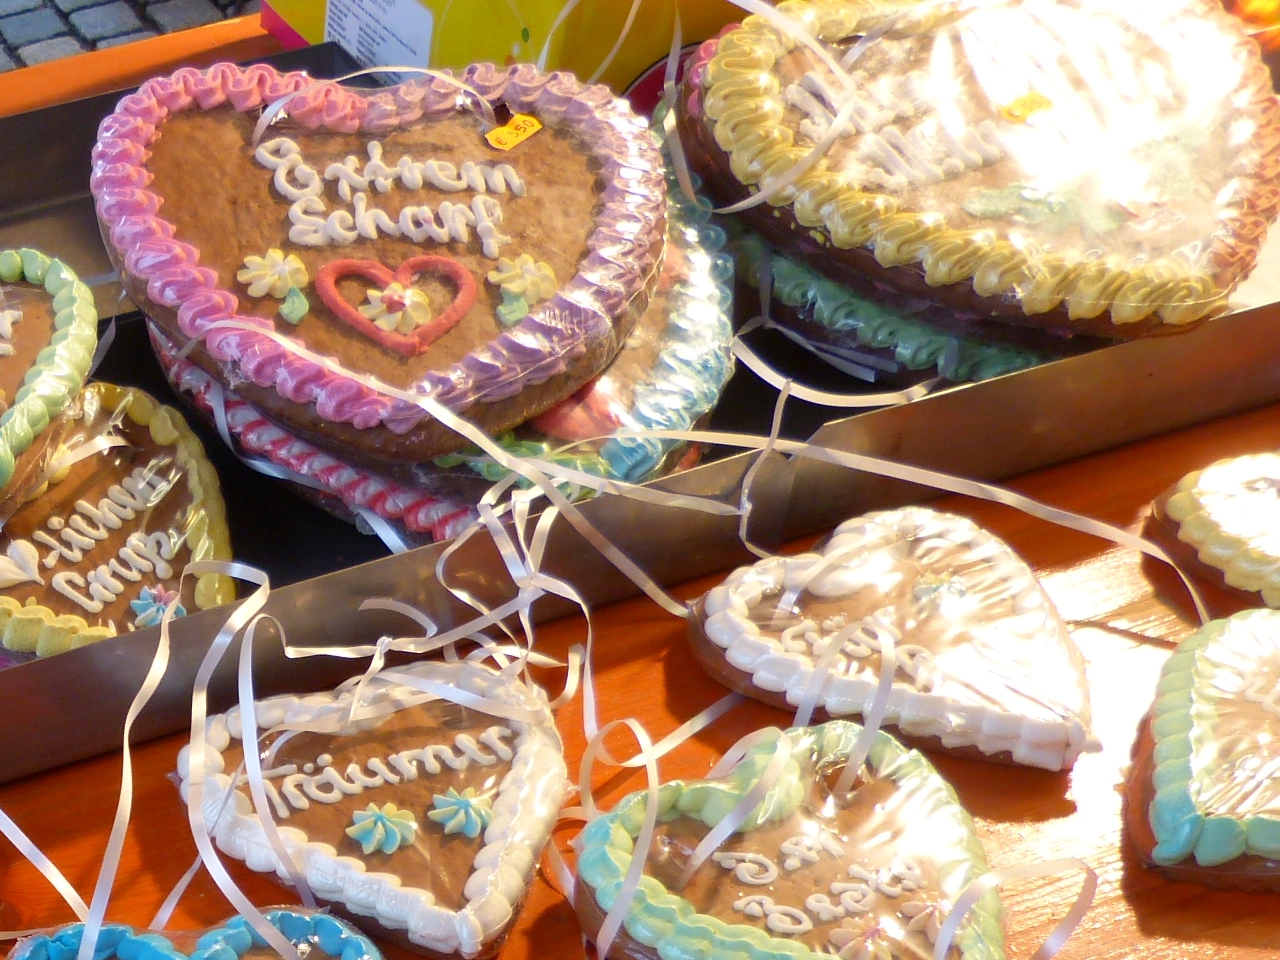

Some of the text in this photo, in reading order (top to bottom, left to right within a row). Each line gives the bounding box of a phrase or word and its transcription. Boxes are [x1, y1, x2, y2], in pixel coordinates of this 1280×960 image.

[507, 118, 535, 139] 5.50
[254, 136, 526, 201] Extrem
[286, 192, 512, 259] Scharf
